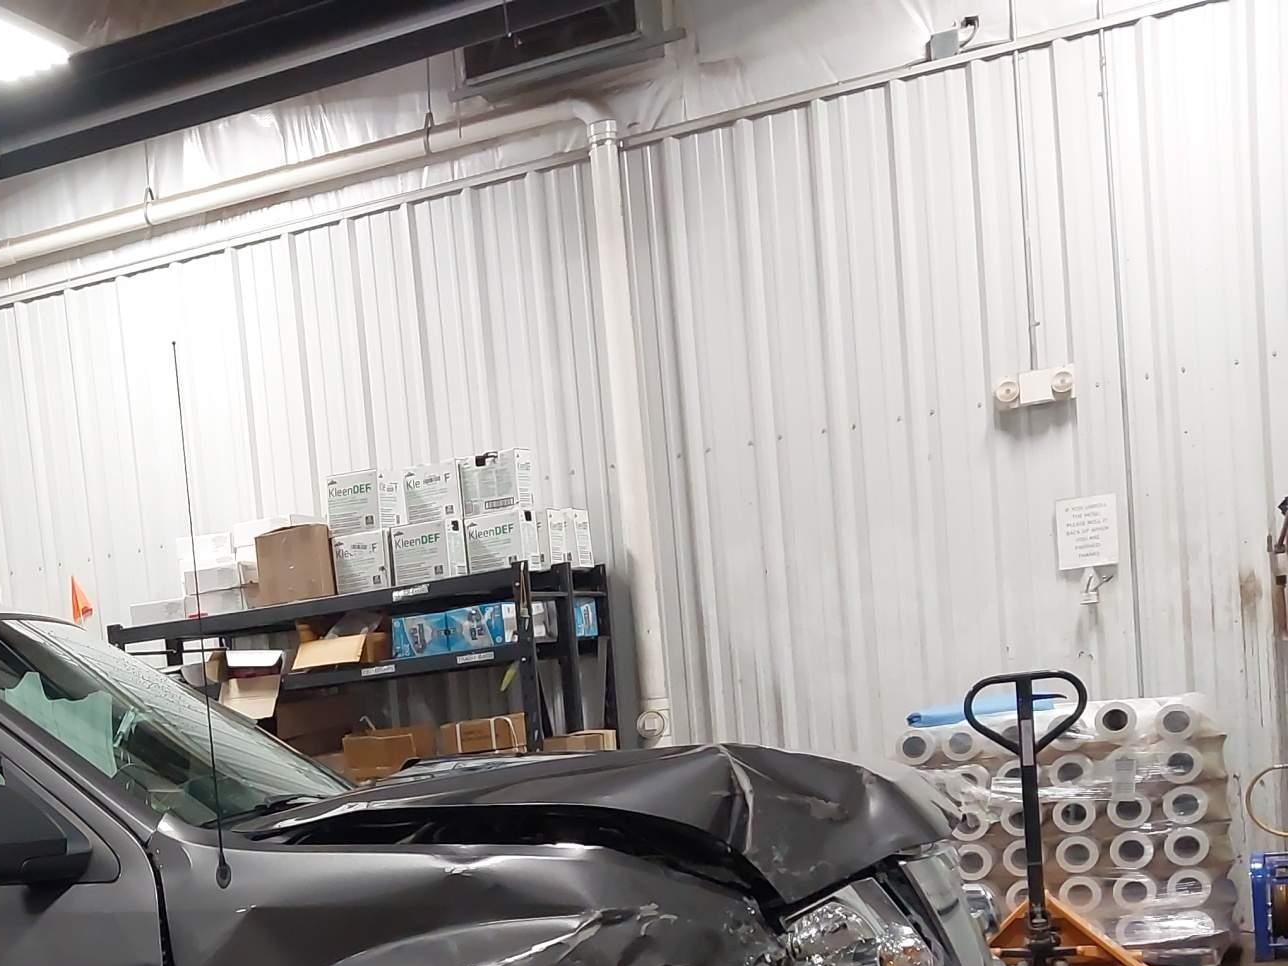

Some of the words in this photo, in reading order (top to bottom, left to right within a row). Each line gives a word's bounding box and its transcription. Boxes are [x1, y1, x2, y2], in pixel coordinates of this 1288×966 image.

[406, 472, 450, 490] KleF
[328, 483, 372, 498] KleenDEF
[468, 523, 514, 540] KleenDEF
[394, 533, 440, 549] KleenDEF
